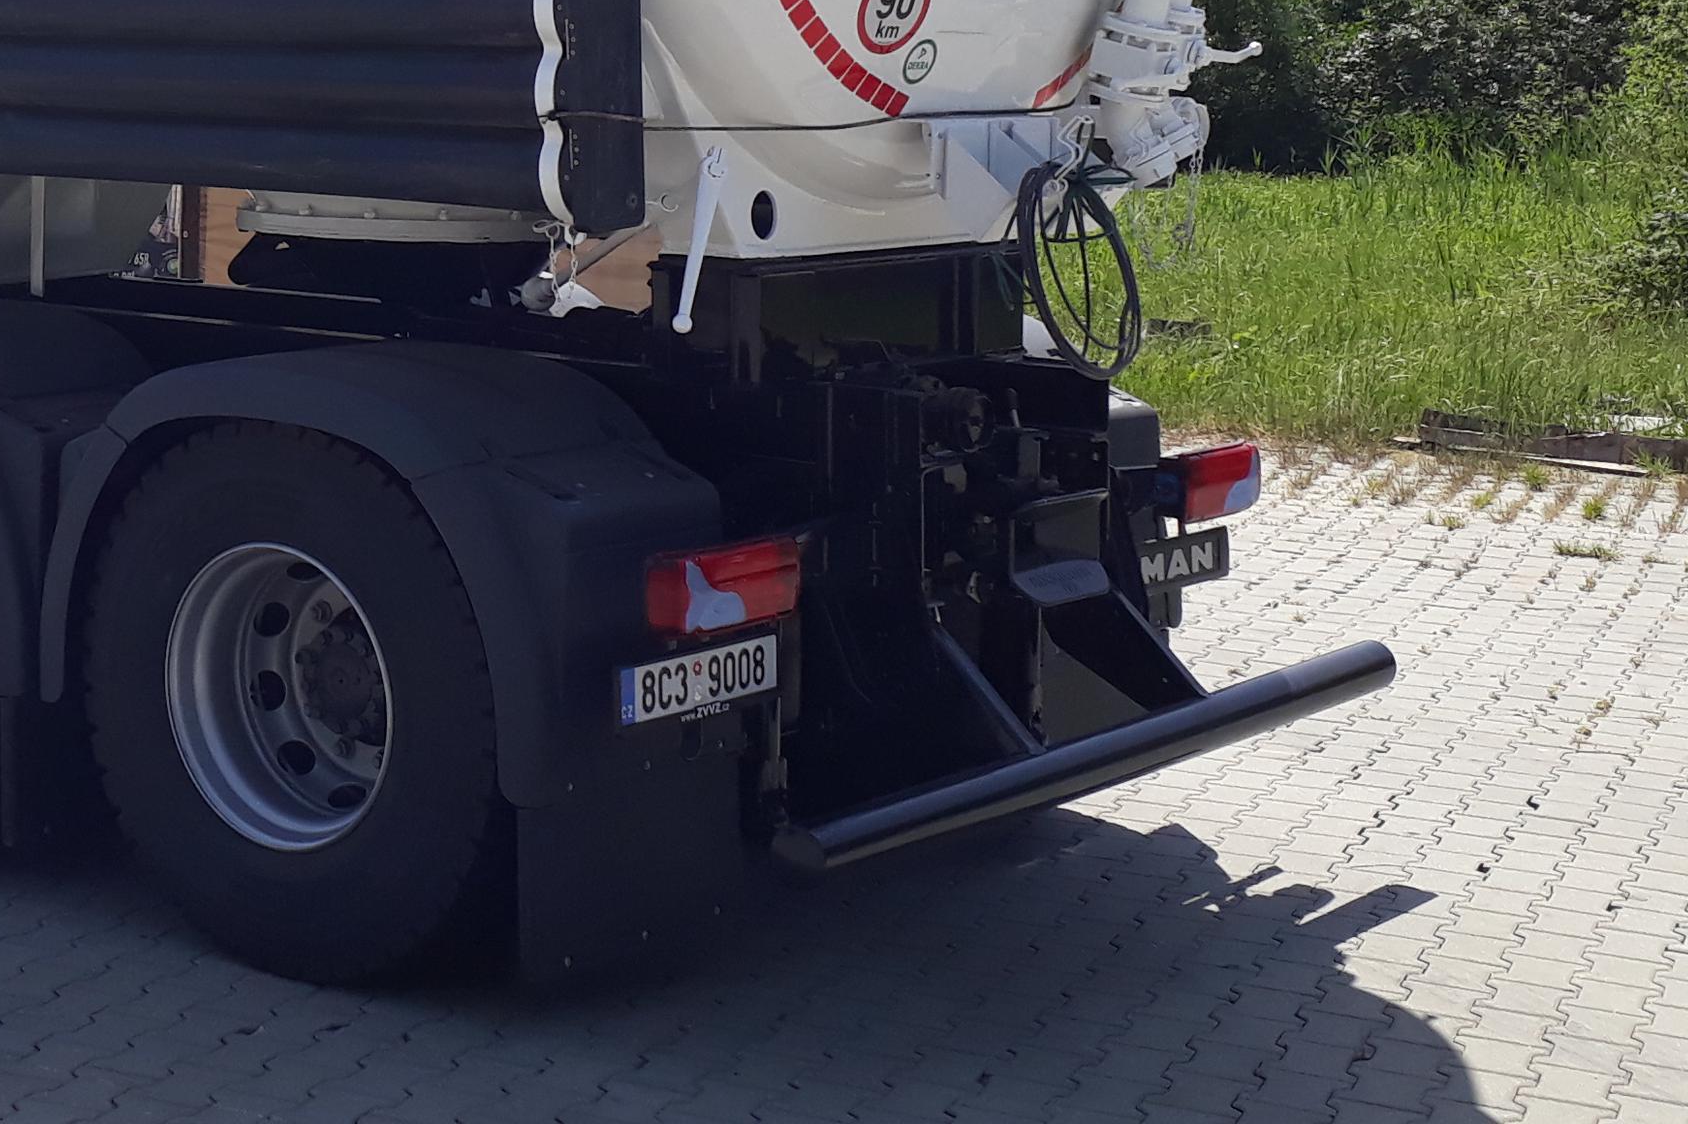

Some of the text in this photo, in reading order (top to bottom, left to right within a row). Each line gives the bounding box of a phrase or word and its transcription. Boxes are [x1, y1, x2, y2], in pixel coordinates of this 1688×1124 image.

[875, 20, 900, 39] km
[1140, 541, 1213, 585] MAN
[641, 644, 765, 714] 8C3 9008
[620, 705, 633, 719] CZ
